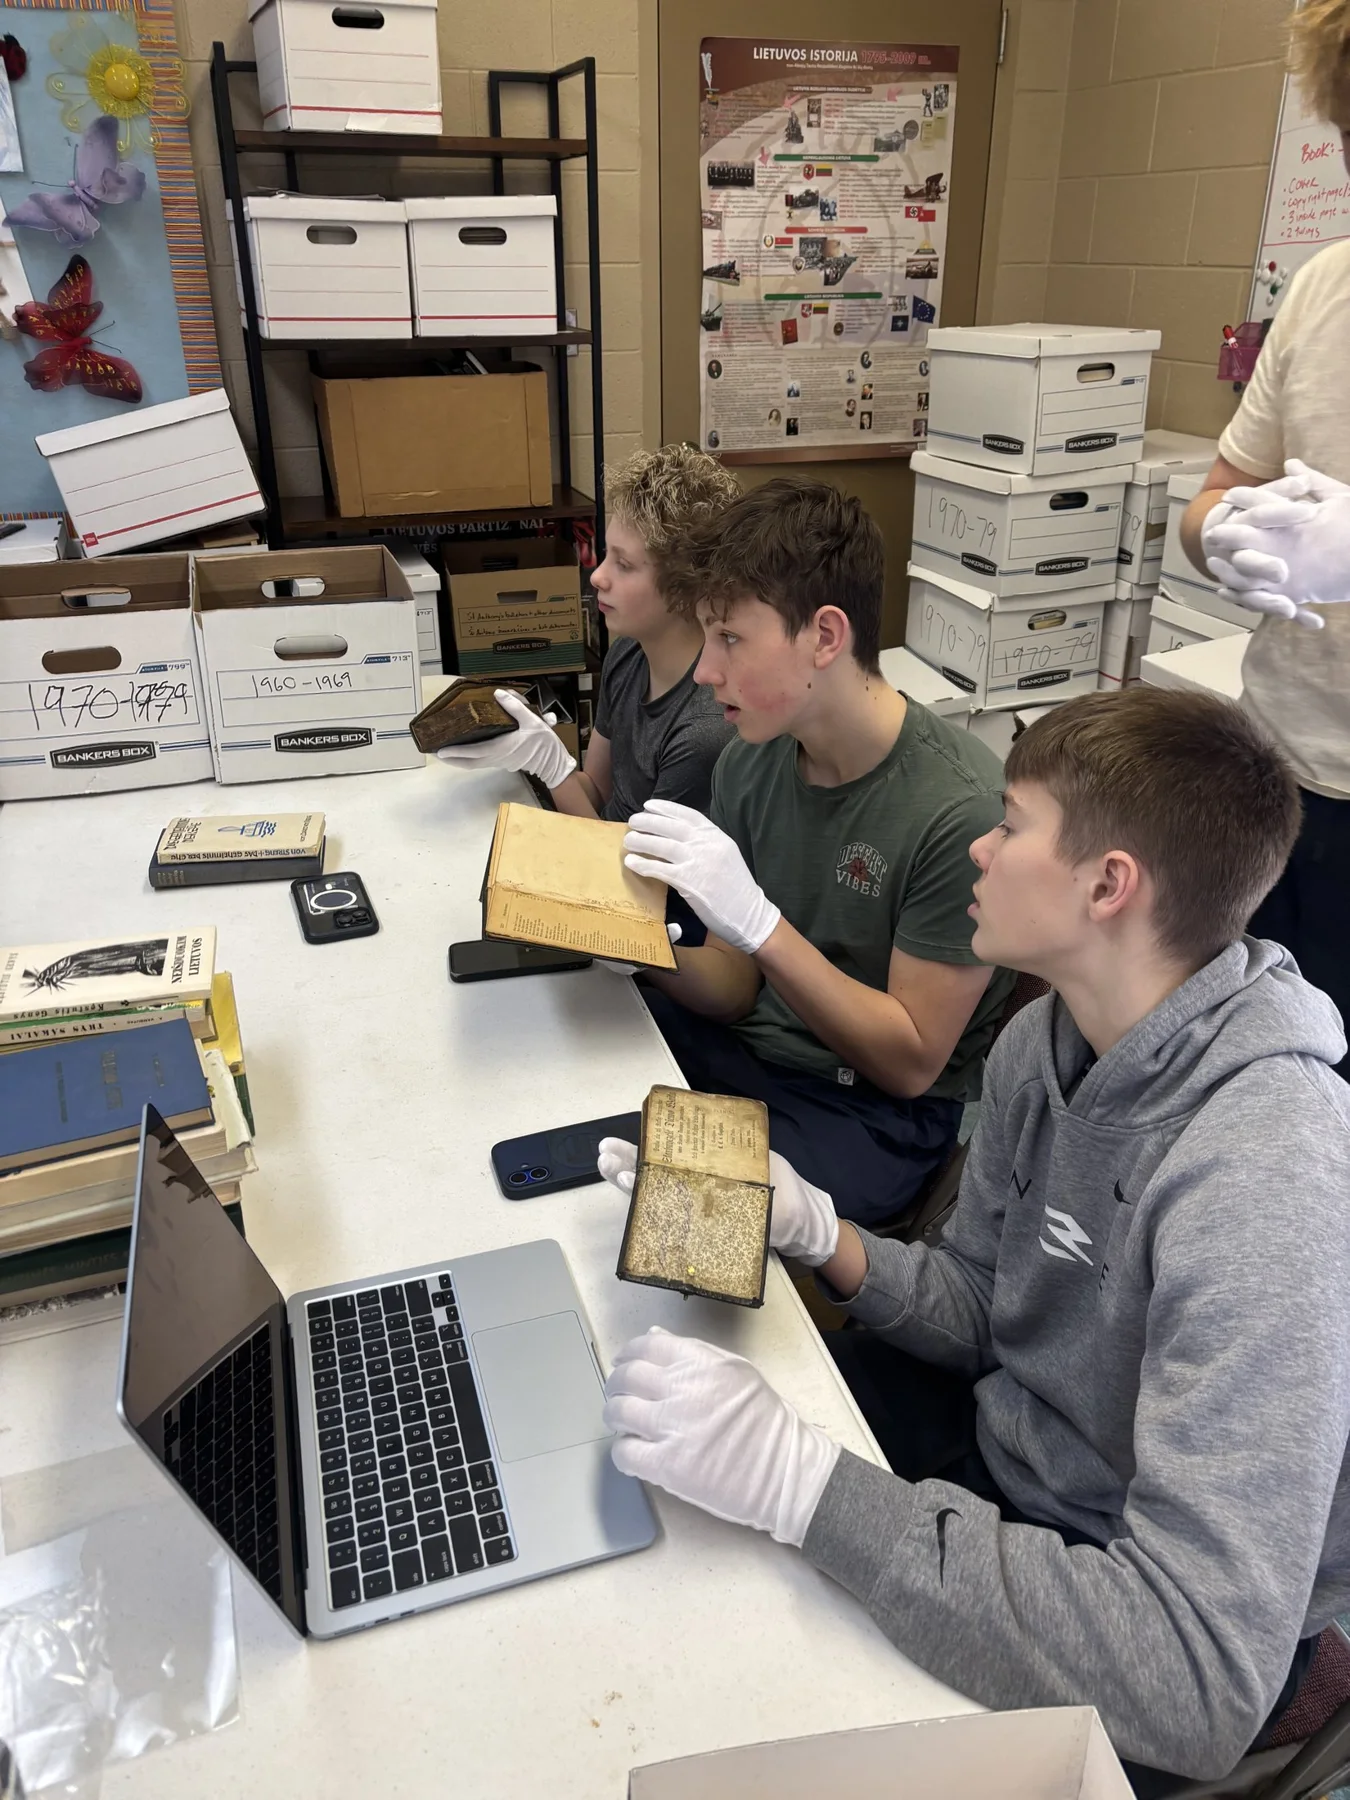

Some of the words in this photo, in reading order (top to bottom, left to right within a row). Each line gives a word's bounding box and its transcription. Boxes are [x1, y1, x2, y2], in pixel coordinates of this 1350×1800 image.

[753, 47, 807, 61] LIETUVOS
[809, 49, 858, 62] ISTORIJA
[861, 51, 917, 65] 1795-2009
[985, 439, 1008, 449] BANKERS
[1068, 438, 1099, 449] BANKERS
[1100, 437, 1115, 445] BOX
[963, 557, 985, 570] BANKERS
[985, 565, 995, 573] BOX
[1038, 562, 1070, 572] BANKERS
[1071, 560, 1086, 568] BOX
[497, 643, 531, 651] BANKERS
[1003, 631, 1096, 673] 1970-79
[963, 682, 975, 690] BOX
[1020, 676, 1054, 687] BANKERS
[1055, 672, 1068, 681] BOX
[280, 735, 340, 747] BANKERS
[340, 733, 367, 742] BOX
[57, 749, 121, 763] BANKERS
[122, 746, 150, 756] BOX
[837, 842, 888, 884] DESERT
[836, 869, 881, 897] VIBES
[189, 937, 203, 977] LIETUVOS
[13, 1010, 48, 1020] Genys
[72, 1022, 105, 1031] TRYS
[10, 1027, 66, 1041] SAKALAI
